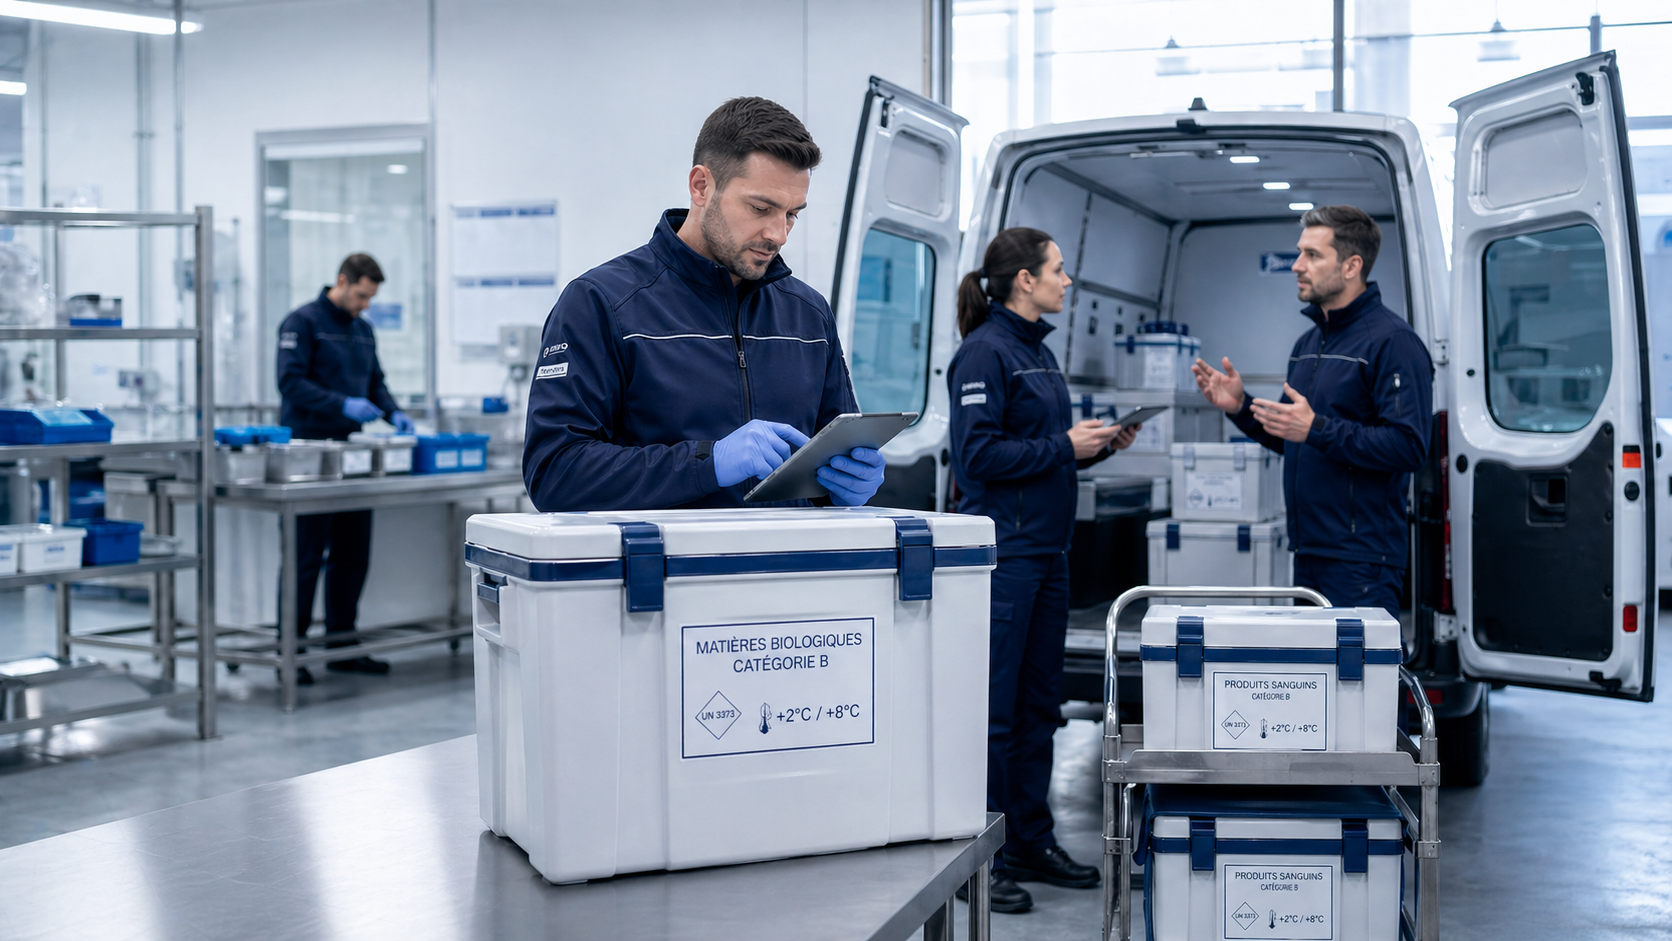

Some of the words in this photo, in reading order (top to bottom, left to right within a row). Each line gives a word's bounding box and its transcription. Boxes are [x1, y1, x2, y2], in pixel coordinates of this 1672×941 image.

[696, 636, 767, 655] MATIÈRES
[770, 632, 862, 651] BIOLOGIQUES
[733, 654, 816, 673] CATÉGORIE
[819, 654, 829, 668] B
[1224, 680, 1269, 689] PRODUITS
[1271, 680, 1318, 690] SANGUINS
[1285, 692, 1291, 700] B
[701, 711, 714, 721] UN
[716, 709, 735, 720] 3373
[776, 707, 812, 723] +2°C
[826, 703, 860, 719] +8°C
[1235, 871, 1278, 880] PRODUITS
[1279, 872, 1323, 881] SANGUINS
